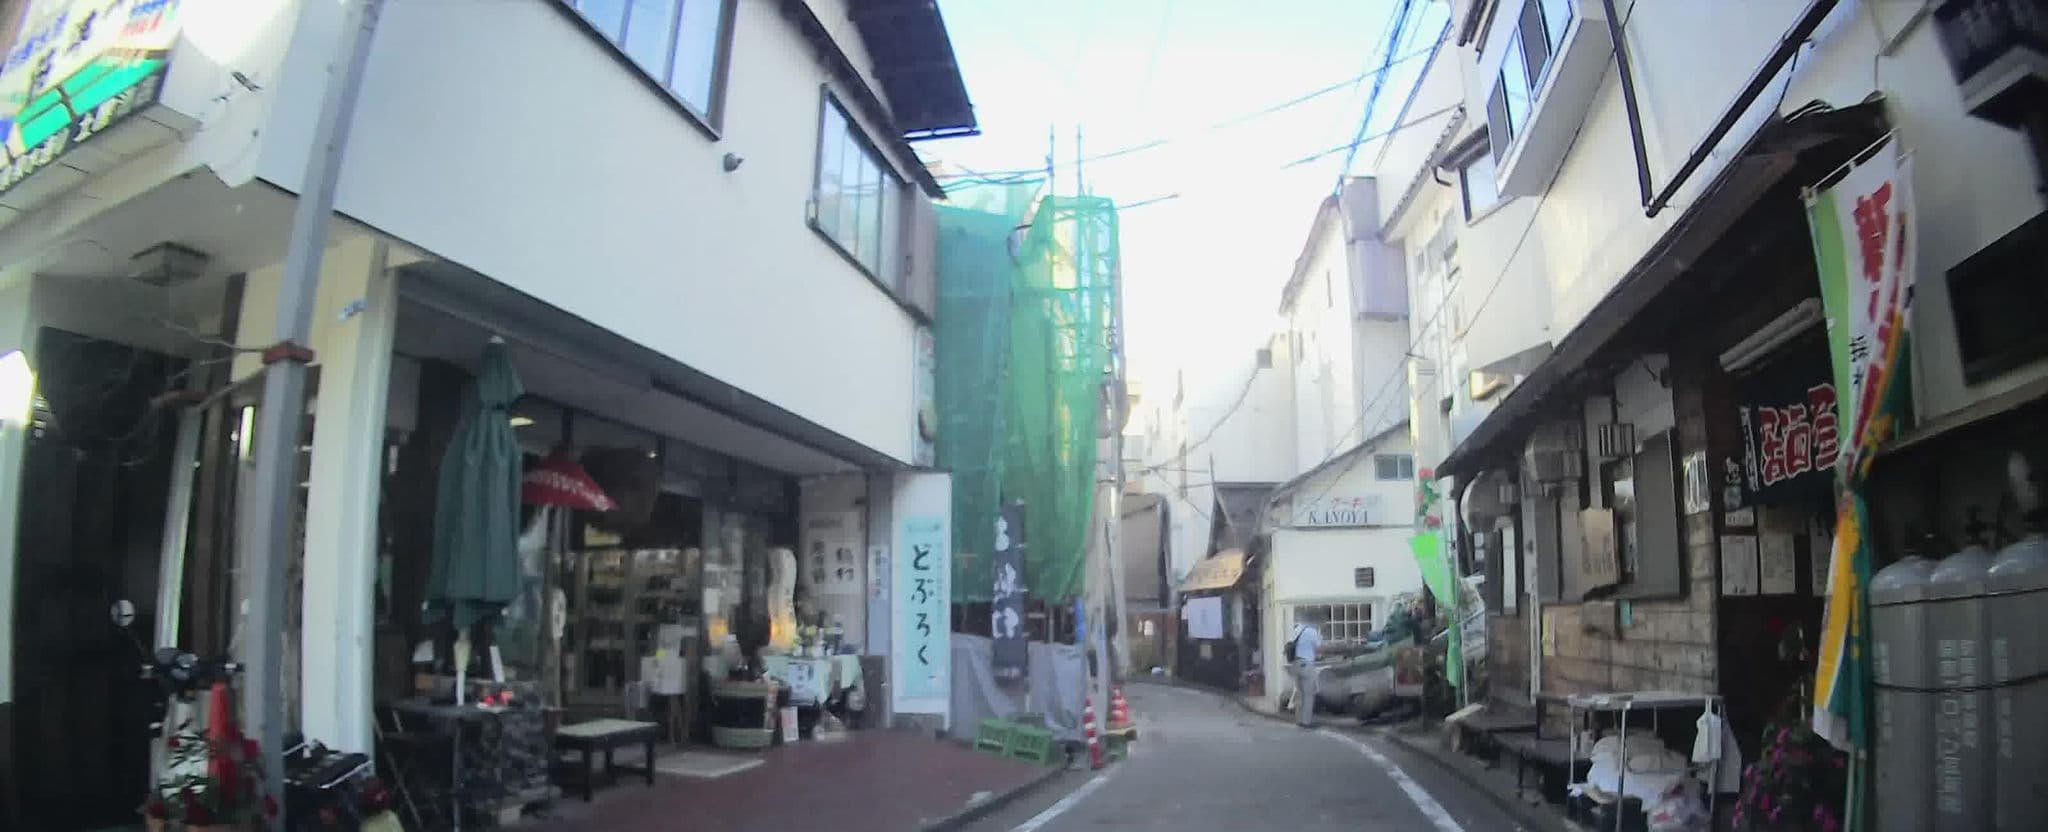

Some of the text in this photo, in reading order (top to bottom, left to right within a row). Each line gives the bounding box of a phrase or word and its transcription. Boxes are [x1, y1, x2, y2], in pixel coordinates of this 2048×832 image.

[1309, 511, 1368, 525] KANOYA
[910, 543, 935, 666] どぶろく
